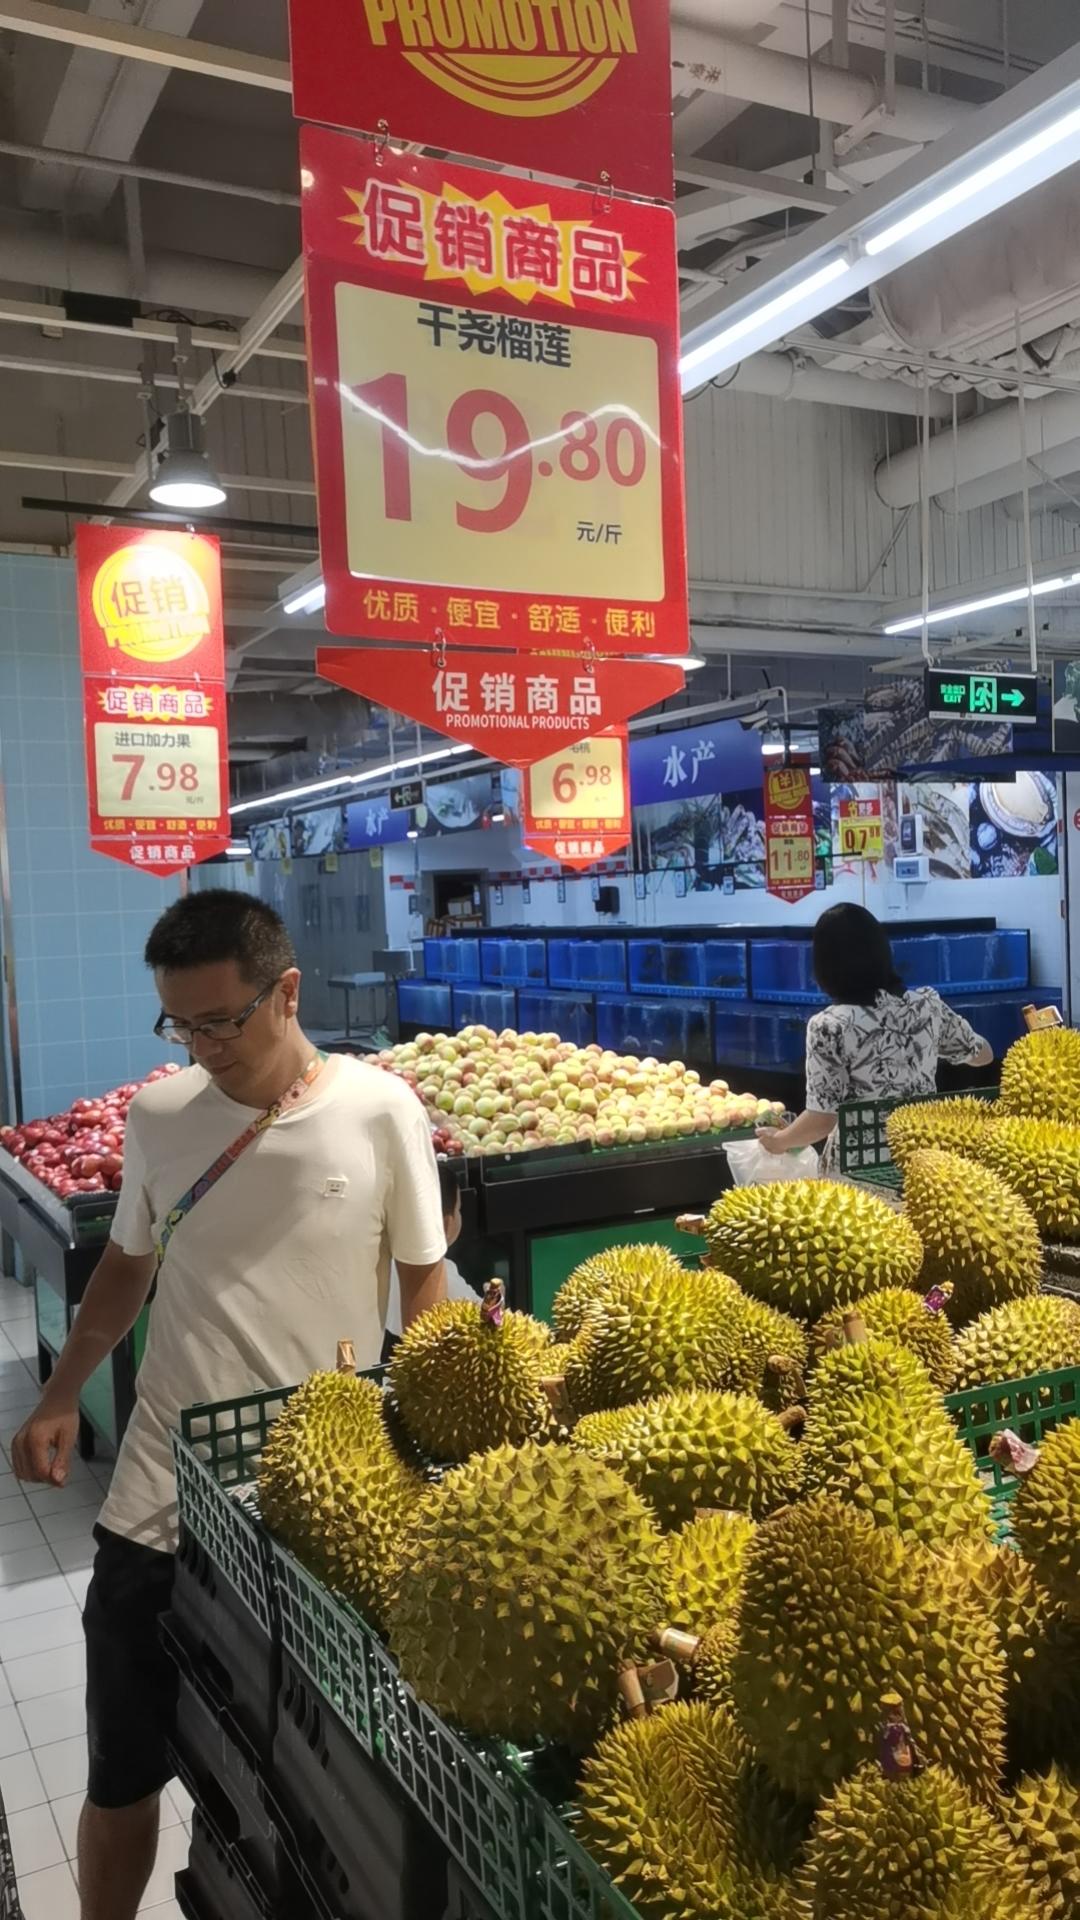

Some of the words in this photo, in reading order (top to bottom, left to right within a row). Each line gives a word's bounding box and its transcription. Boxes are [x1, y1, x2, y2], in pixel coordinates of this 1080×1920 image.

[363, 0, 637, 54] PROMOTION
[362, 180, 627, 300] 促销商品
[417, 302, 571, 367] 干尧榴莲
[351, 373, 646, 533] 19.80
[576, 521, 622, 544] 元/斤
[112, 573, 188, 618] 促销
[107, 690, 204, 714] 促销商品
[432, 671, 601, 715] 促销商品
[114, 732, 191, 748] 进口加力果
[446, 714, 530, 729] PROMOTIONAL
[532, 715, 590, 730] PRODUCTS
[112, 754, 199, 801] 7.98
[552, 763, 612, 803] 6.98
[662, 739, 716, 788] 水产
